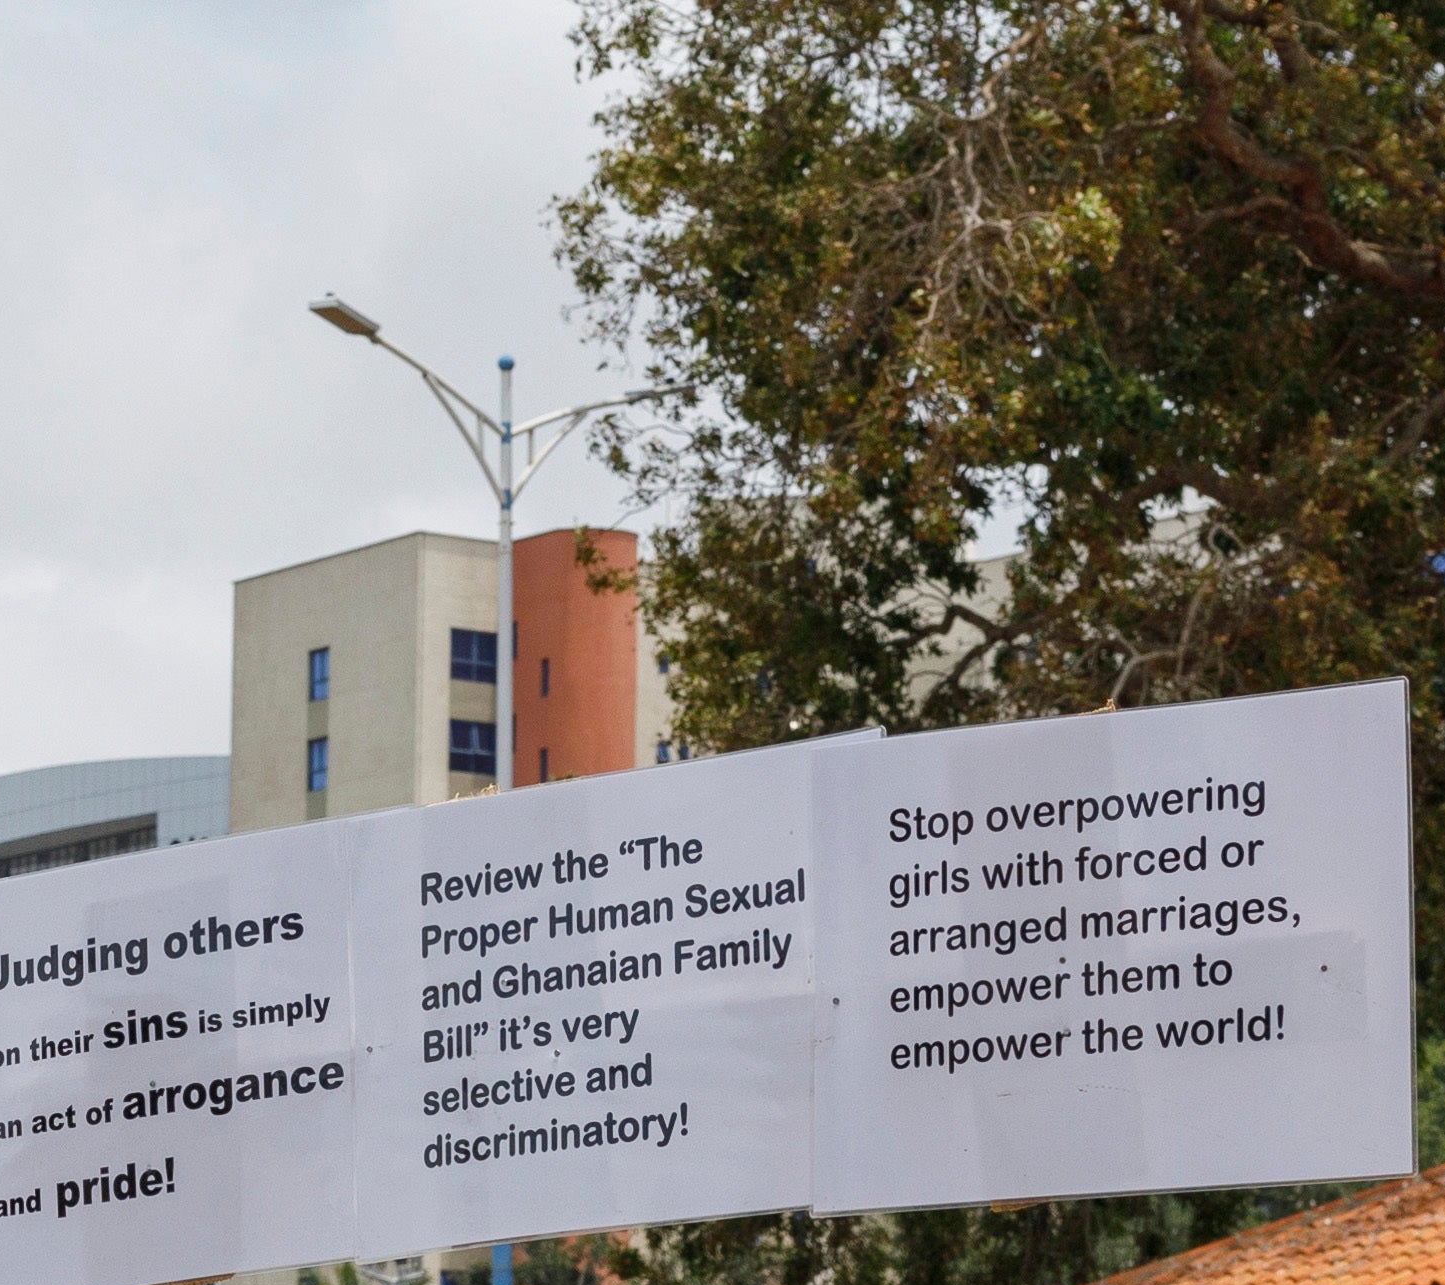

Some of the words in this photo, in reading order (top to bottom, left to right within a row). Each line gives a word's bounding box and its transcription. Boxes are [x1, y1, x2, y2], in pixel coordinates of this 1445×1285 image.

[889, 806, 974, 846] Stop
[985, 776, 1266, 834] overpowering
[420, 862, 544, 907] Review
[551, 849, 609, 885] the
[619, 834, 703, 872] “The
[889, 859, 970, 909] girls
[981, 850, 1063, 891] with
[1074, 835, 1207, 882] forced
[1220, 839, 1265, 869] or
[163, 912, 304, 960] others
[421, 916, 539, 959] Proper
[548, 896, 674, 939] Human
[685, 867, 806, 919] Sexual
[889, 905, 1067, 957] arranged
[1080, 895, 1301, 940] marriages,
[421, 969, 482, 1012] and
[492, 949, 662, 999] Ghanaian
[674, 927, 792, 975] Family
[890, 972, 1071, 1018] empower
[1081, 960, 1180, 997] them
[1192, 952, 1233, 988] to
[29, 1033, 95, 1062] their
[102, 1009, 189, 1049] sins
[198, 1013, 223, 1034] is
[232, 993, 331, 1029] simply
[423, 1021, 489, 1064] Bill”
[499, 1015, 552, 1052] it’s
[561, 1008, 640, 1045] very
[890, 1029, 1072, 1075] empower
[1081, 1018, 1144, 1055] the
[1155, 1004, 1285, 1049] world!
[31, 1104, 77, 1135] act
[85, 1097, 114, 1126] of
[122, 1062, 345, 1121] arrogance
[423, 1068, 576, 1116] selective
[585, 1052, 653, 1094] and
[423, 1101, 689, 1169] discriminatory!
[56, 1156, 175, 1219] pride!
